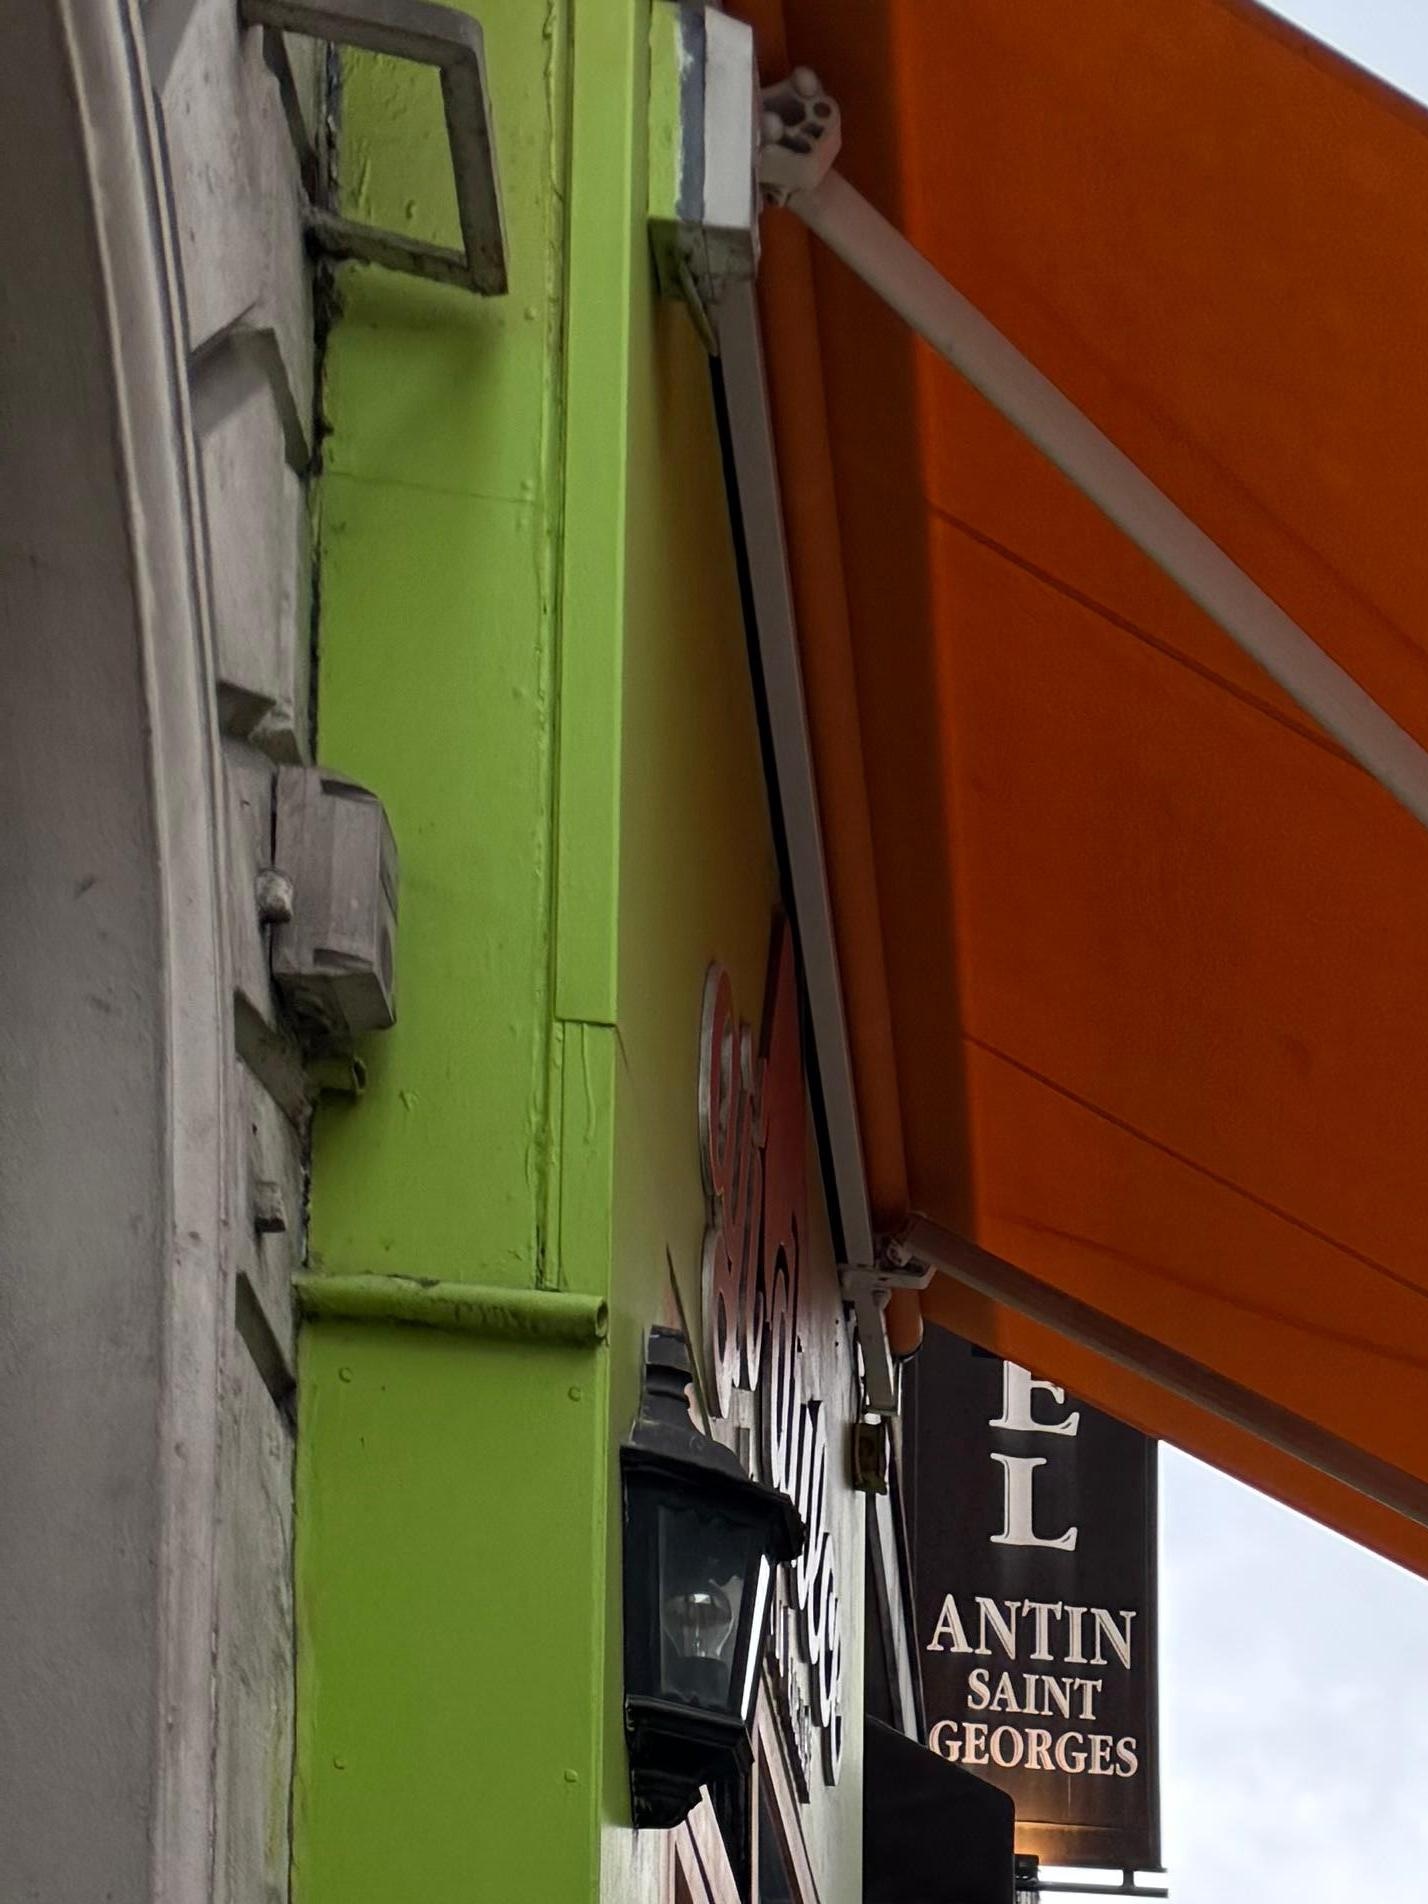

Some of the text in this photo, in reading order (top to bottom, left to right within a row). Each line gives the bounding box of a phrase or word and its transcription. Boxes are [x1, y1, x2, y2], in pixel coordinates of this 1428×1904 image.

[926, 1593, 1136, 1669] ANTIN
[967, 1668, 1102, 1721] SAINT
[929, 1719, 1139, 1778] GEORGES
